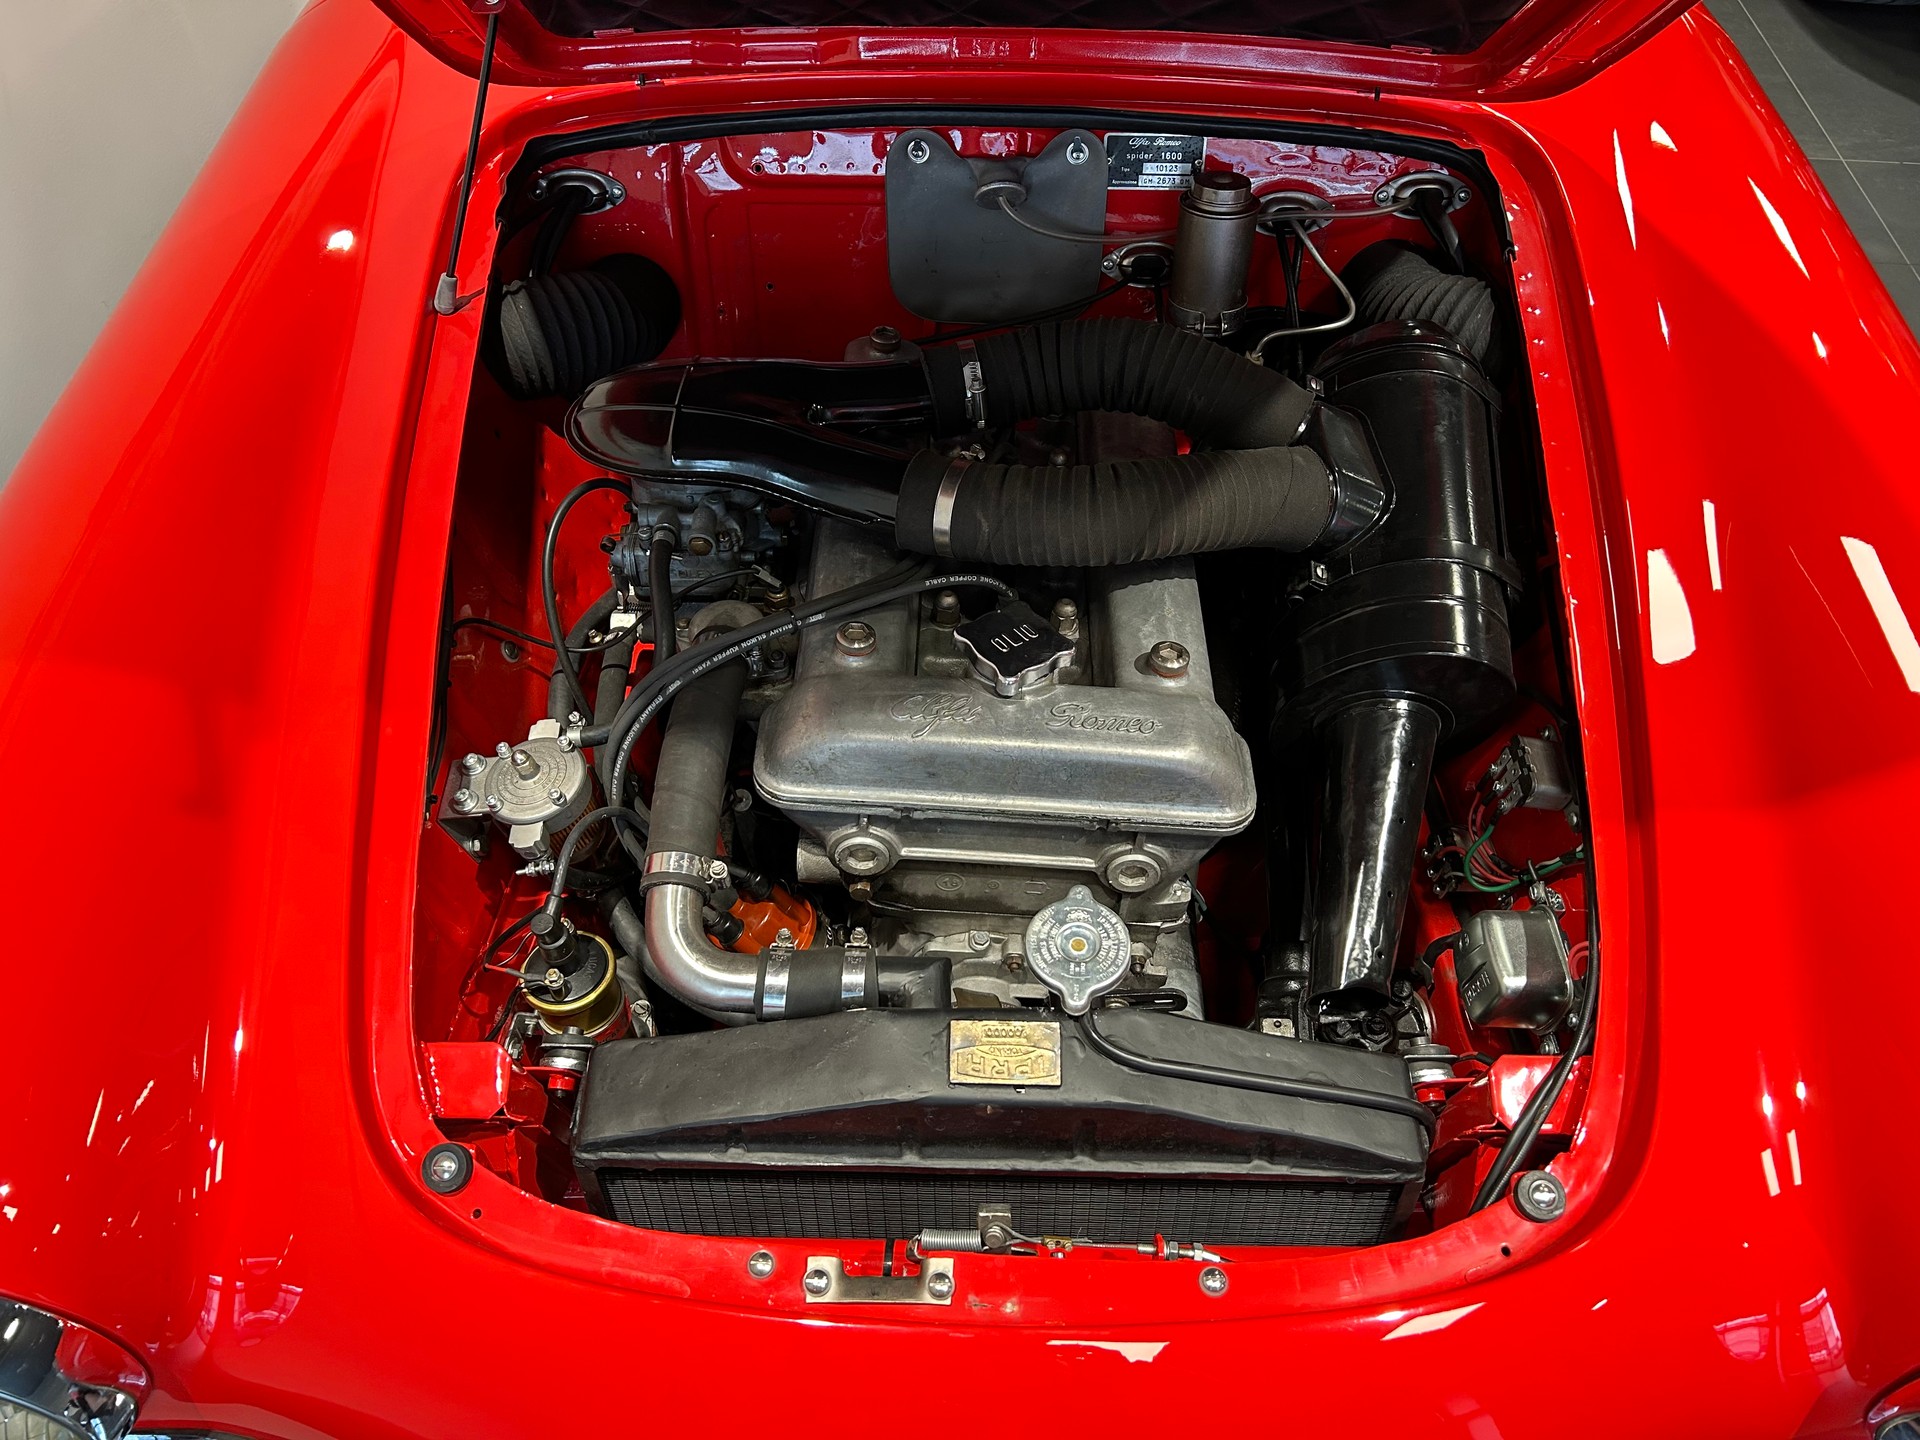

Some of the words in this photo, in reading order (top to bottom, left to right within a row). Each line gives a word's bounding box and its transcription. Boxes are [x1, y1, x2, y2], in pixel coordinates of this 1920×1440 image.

[1129, 137, 1151, 149] Alfa
[1153, 137, 1182, 146] Romeo
[1126, 152, 1153, 160] spider
[1161, 152, 1182, 160] 1600
[1155, 165, 1179, 173] 10123
[1157, 177, 1176, 185] 2673
[925, 577, 947, 586] CABLE
[770, 620, 802, 636] GRMANY
[741, 632, 767, 648] SILIKON
[990, 623, 1039, 653] OLIO
[713, 646, 739, 662] KUPFER
[890, 694, 984, 739] Alfa
[1046, 702, 1163, 735] Romeo
[622, 722, 640, 750] SILICONE
[614, 751, 625, 777] COPPER
